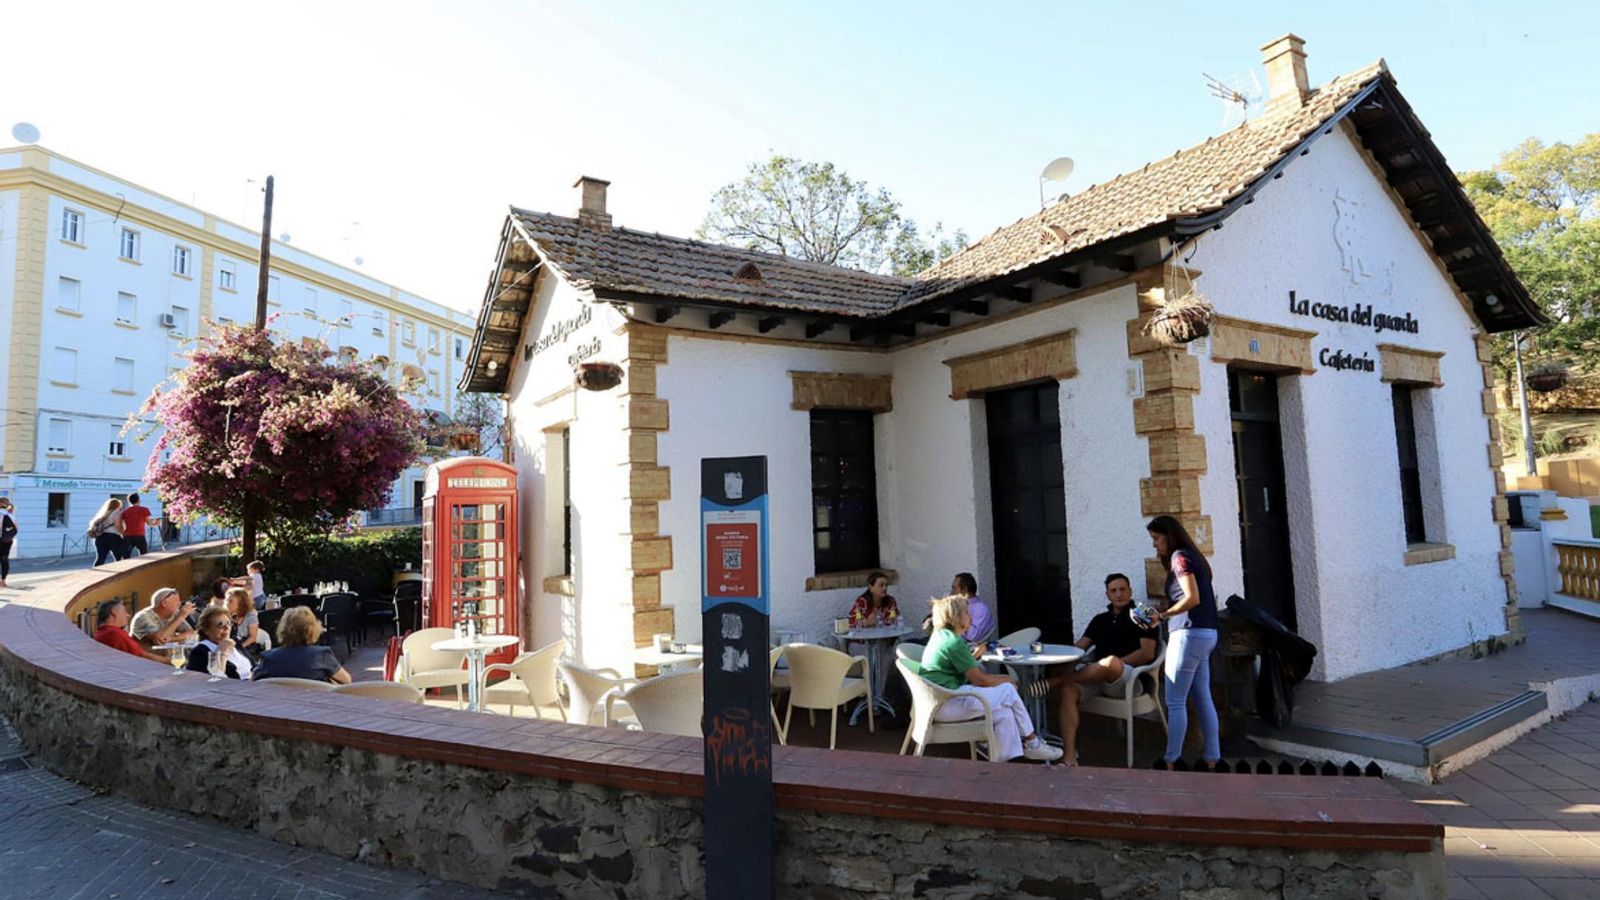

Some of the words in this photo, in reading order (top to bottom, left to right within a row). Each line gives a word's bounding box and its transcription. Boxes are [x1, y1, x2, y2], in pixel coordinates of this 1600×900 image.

[1288, 290, 1309, 315] La
[1311, 302, 1348, 322] casa
[1351, 303, 1372, 326] del
[1374, 312, 1419, 334] guarda
[1319, 348, 1375, 372] Cafetería
[42, 479, 78, 488] Menudo
[450, 478, 506, 488] TELEPHONE
